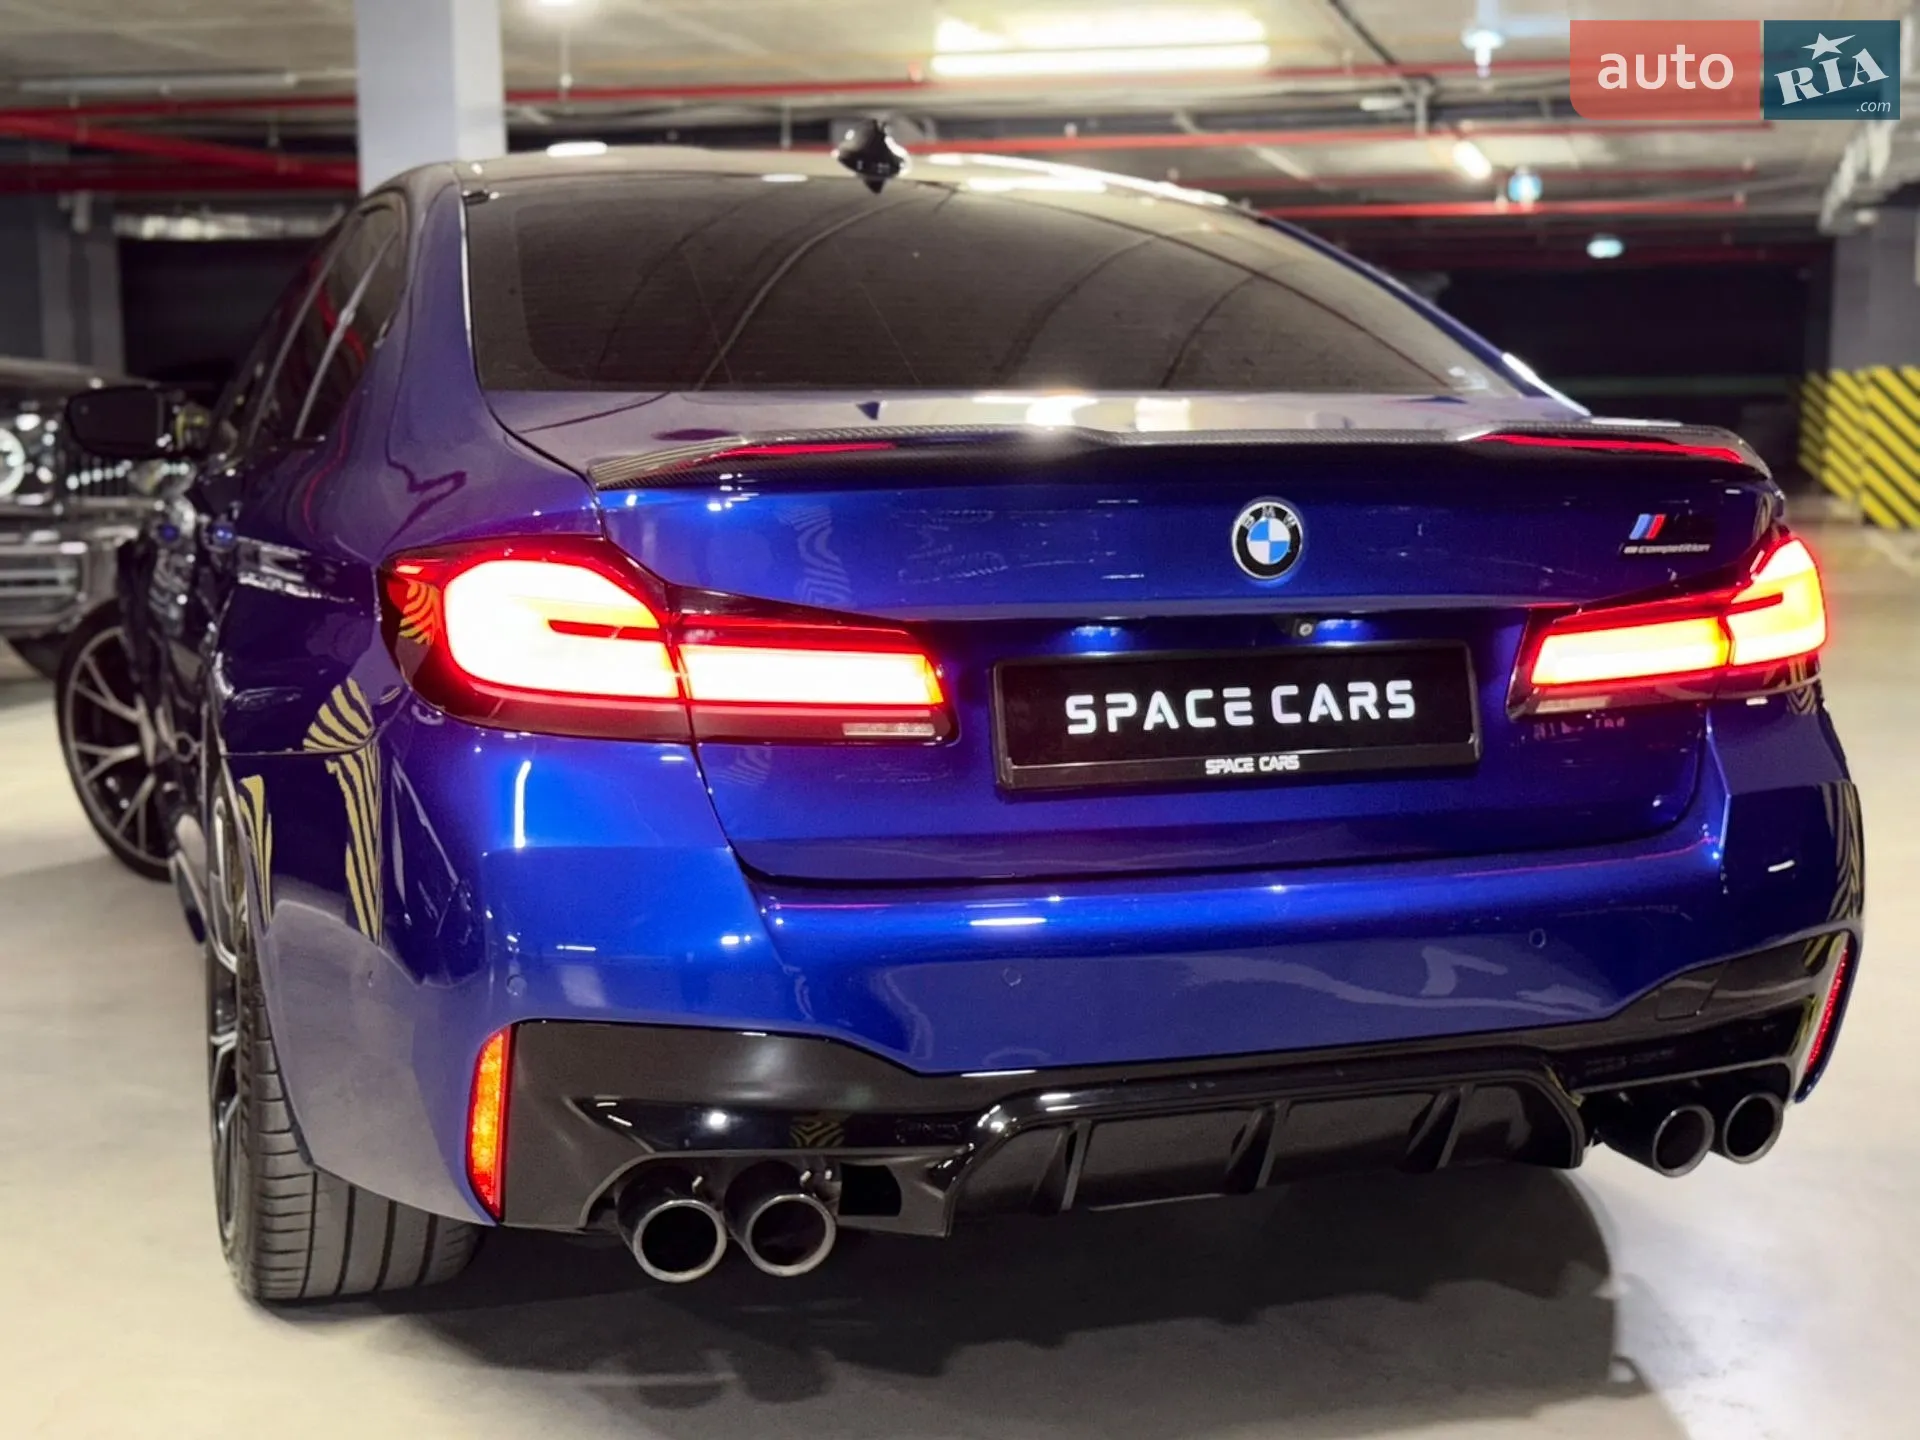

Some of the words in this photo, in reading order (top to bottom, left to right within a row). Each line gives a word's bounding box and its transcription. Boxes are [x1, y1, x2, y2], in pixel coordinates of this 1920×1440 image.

[1065, 686, 1254, 735] SPACE
[1271, 679, 1416, 724] CARS
[1205, 757, 1255, 775] SPACE
[1259, 754, 1300, 771] CARS
